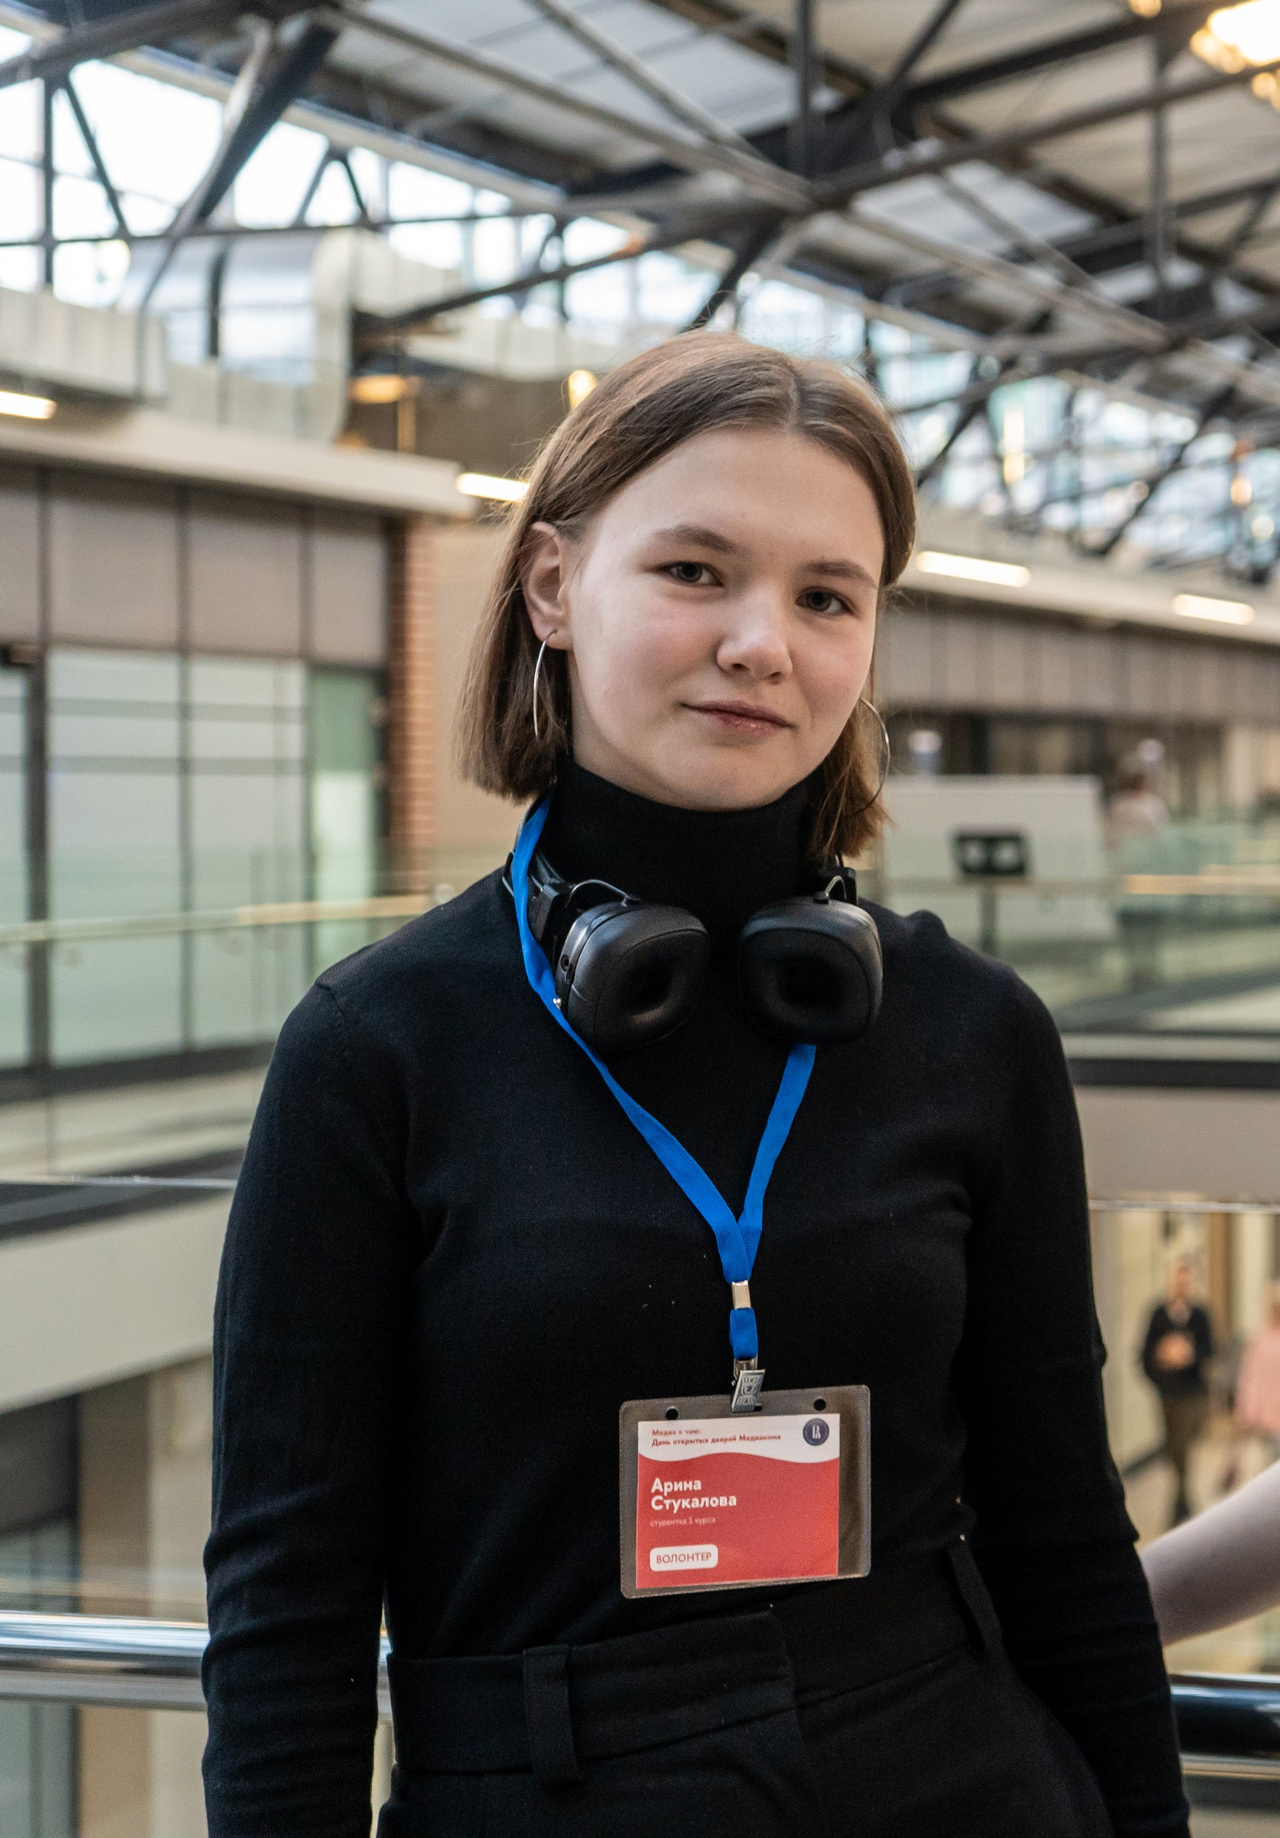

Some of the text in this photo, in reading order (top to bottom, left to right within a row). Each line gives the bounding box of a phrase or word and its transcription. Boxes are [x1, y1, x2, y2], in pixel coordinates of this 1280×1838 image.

[652, 1438, 671, 1447] День
[673, 1438, 709, 1446] открытых
[650, 1477, 702, 1496] Арина
[650, 1495, 737, 1514] Стукалова
[656, 1552, 712, 1565] ВОЛОНТЕР
